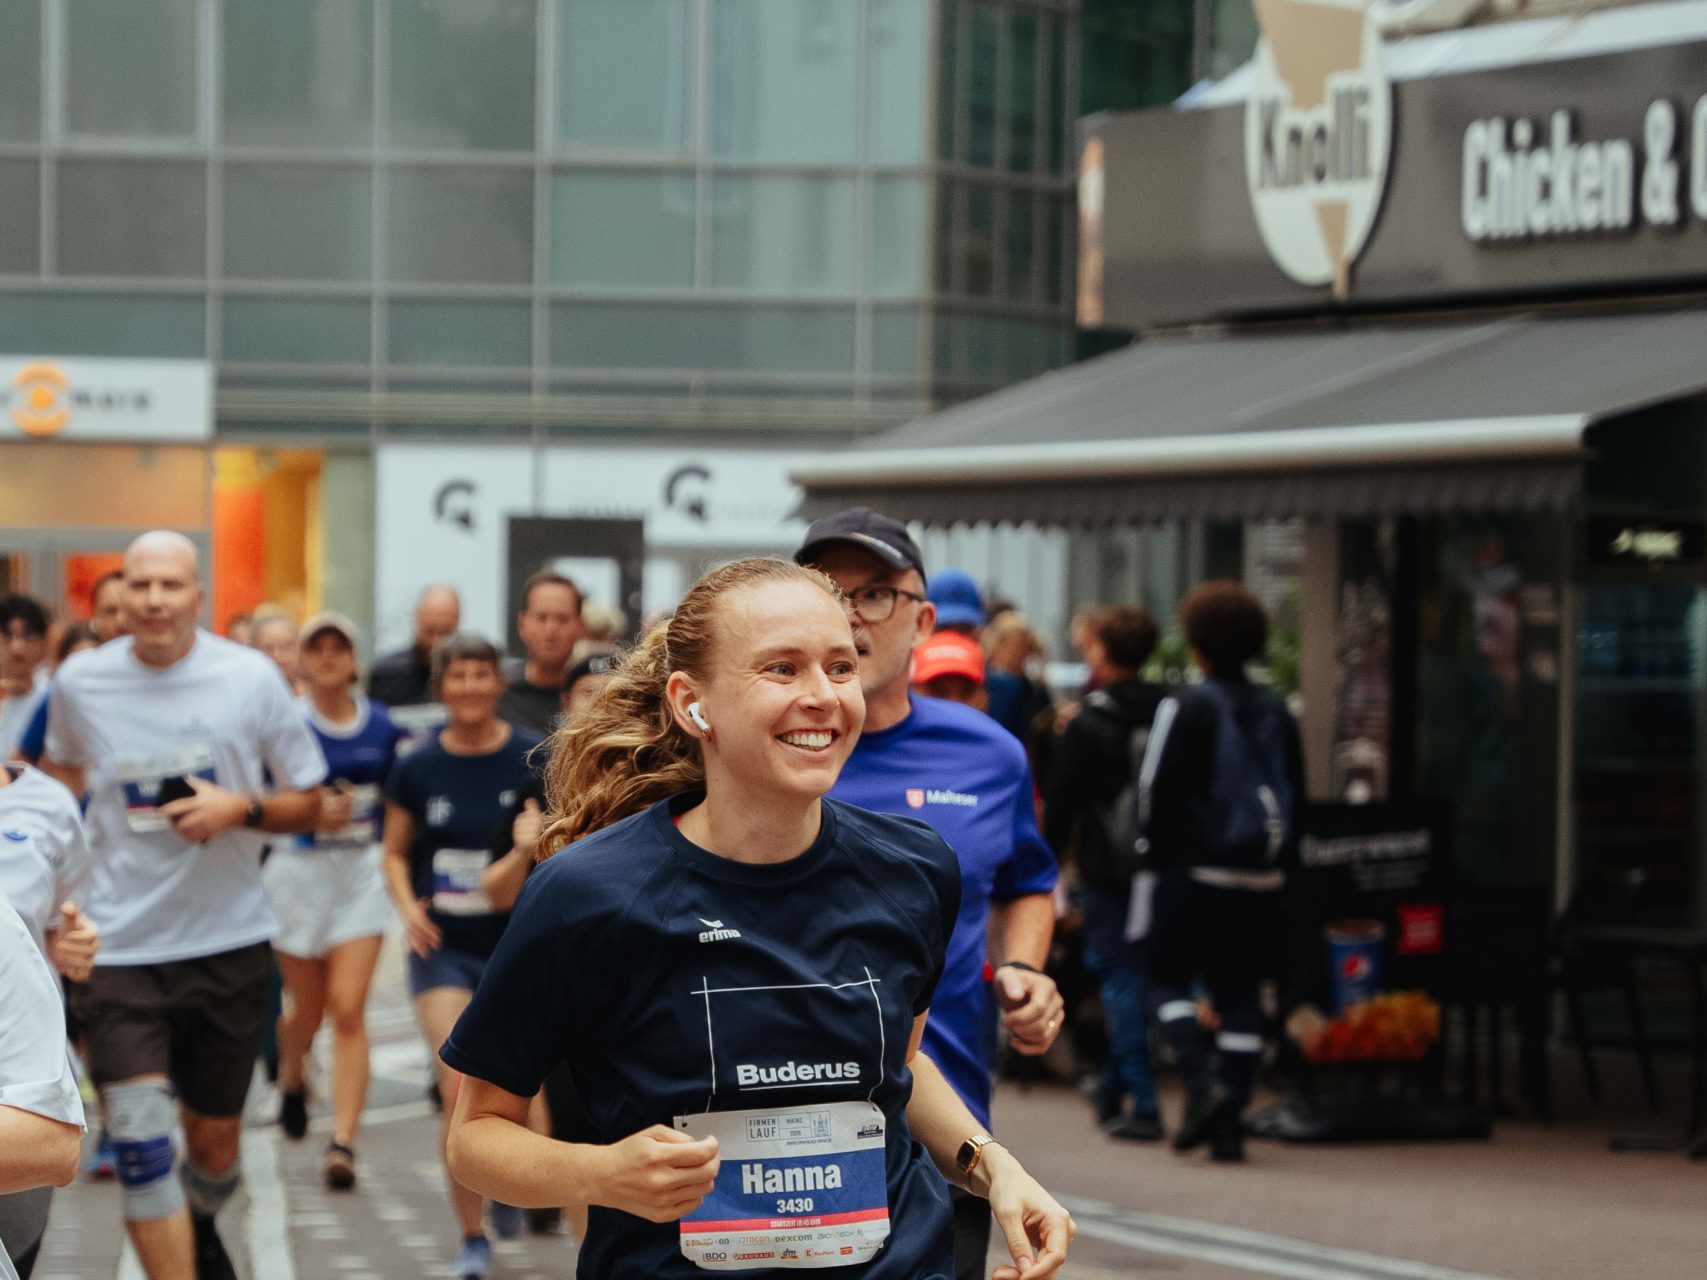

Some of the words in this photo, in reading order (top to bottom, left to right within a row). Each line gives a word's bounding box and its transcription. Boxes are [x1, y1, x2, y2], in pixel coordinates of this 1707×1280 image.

[1462, 110, 1634, 240] Chicken
[1642, 99, 1680, 224] &
[699, 928, 742, 943] erima
[736, 1061, 861, 1085] Buderus
[749, 1118, 776, 1127] FIRMEN
[750, 1127, 776, 1139] LAUF
[741, 1163, 843, 1194] Hanna
[776, 1198, 814, 1214] 3430
[705, 1252, 727, 1260] BDO
[782, 1248, 797, 1256] dm
